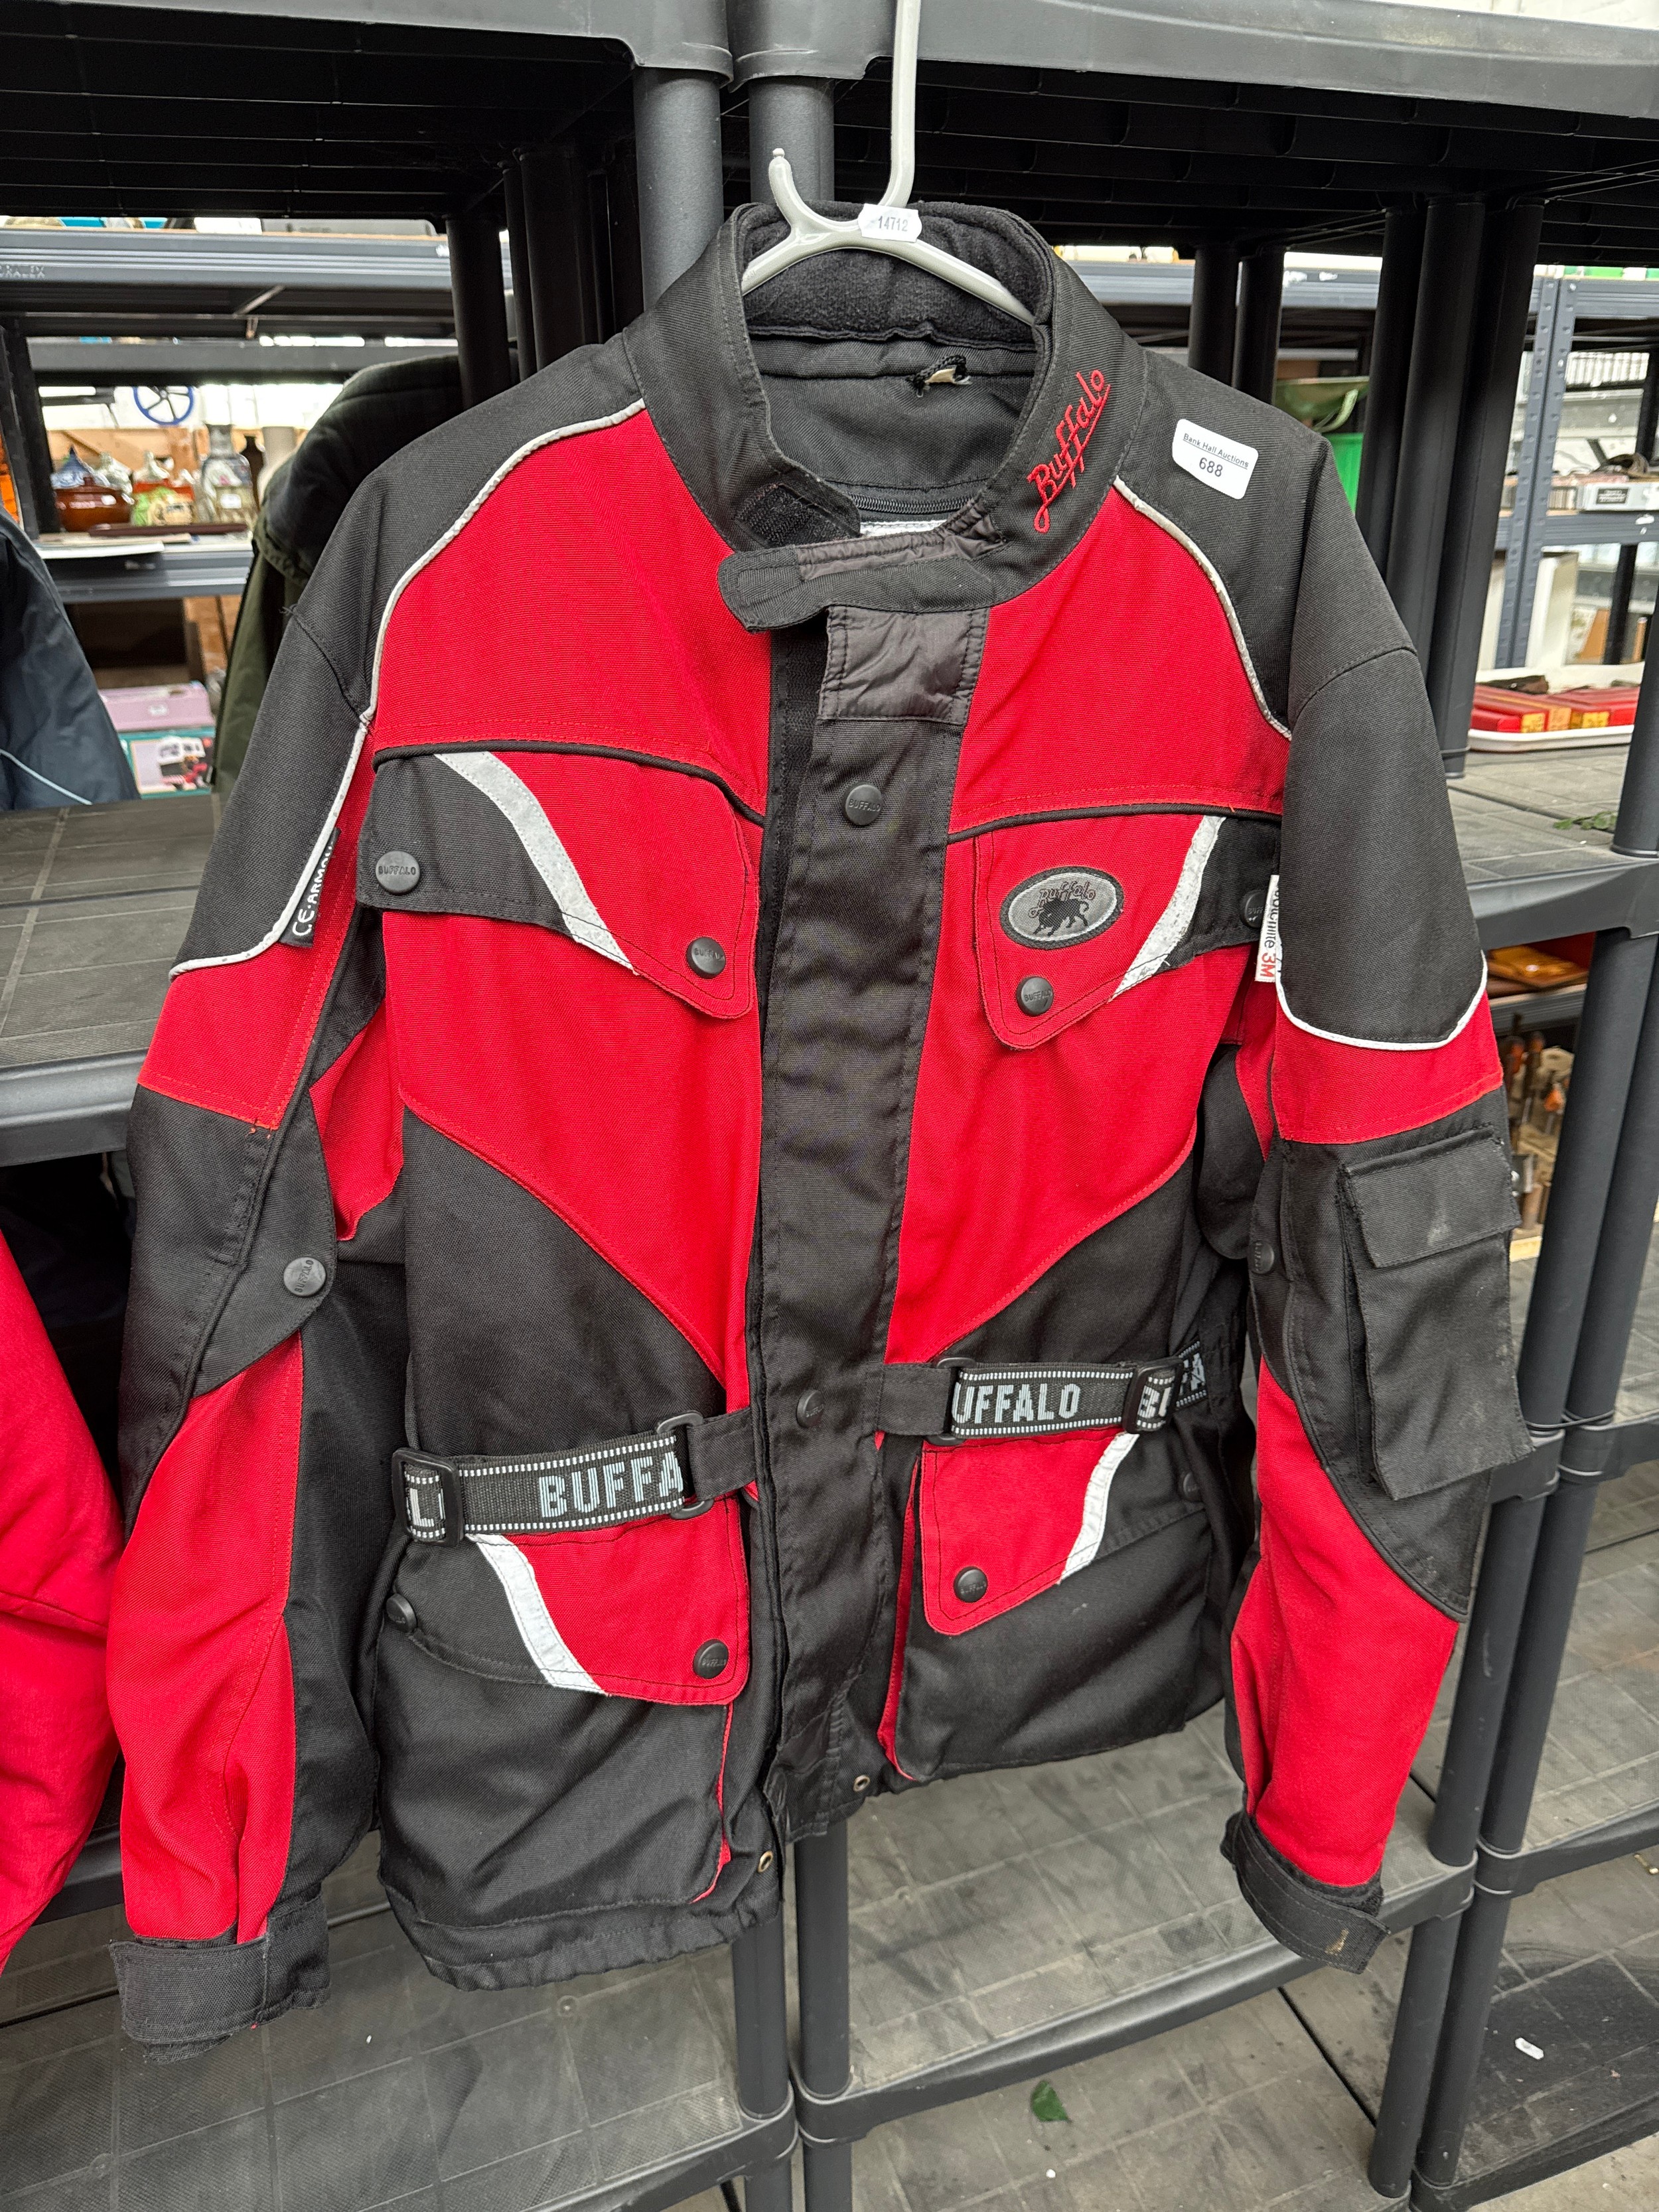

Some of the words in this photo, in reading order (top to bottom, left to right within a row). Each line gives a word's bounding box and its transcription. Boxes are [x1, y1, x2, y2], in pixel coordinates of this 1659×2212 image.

[877, 215, 908, 232] 14712
[1026, 369, 1111, 533] Buffalo
[1183, 433, 1201, 447] Bank
[1202, 442, 1217, 453] Hall
[1217, 449, 1250, 469] Auctions
[1198, 457, 1224, 477] 688
[378, 865, 417, 875] BUFFALO
[1260, 952, 1276, 977] 3M
[294, 1259, 315, 1293] BUFFALO
[538, 1451, 684, 1518] BUFFA
